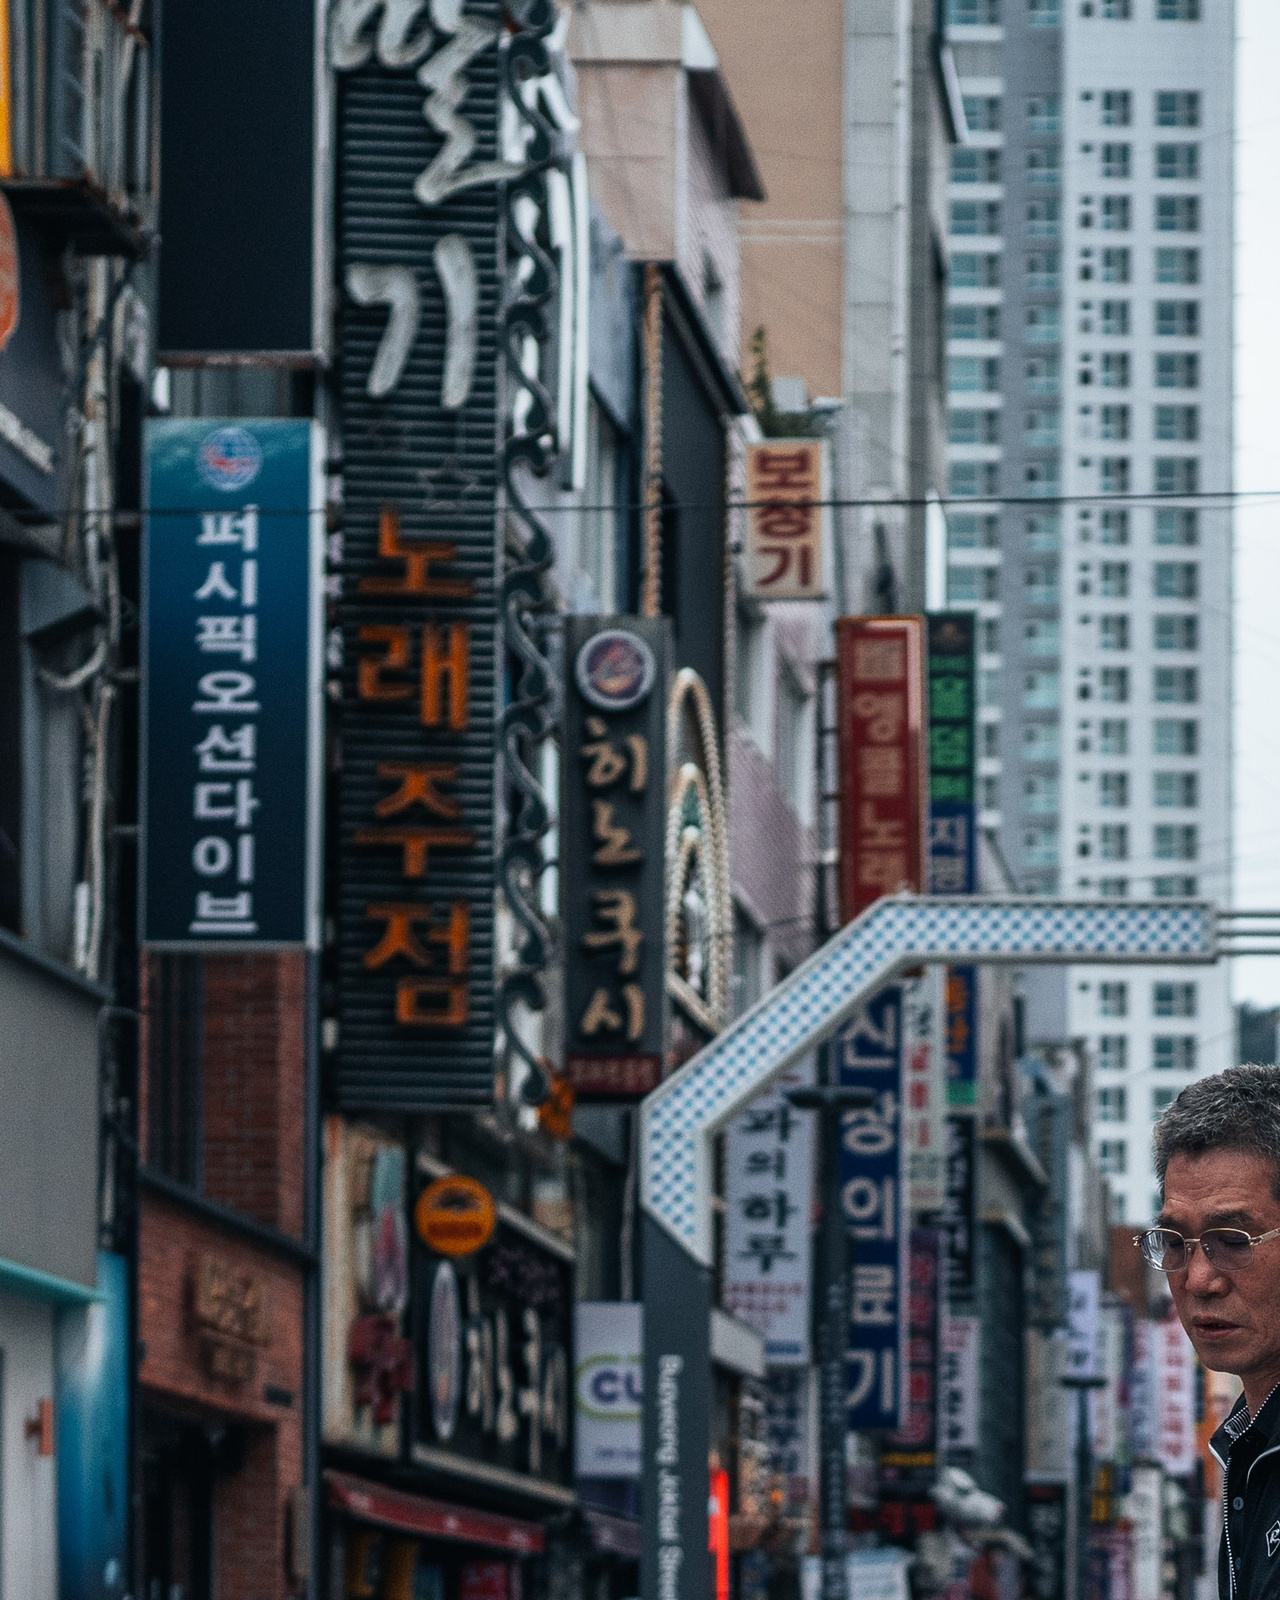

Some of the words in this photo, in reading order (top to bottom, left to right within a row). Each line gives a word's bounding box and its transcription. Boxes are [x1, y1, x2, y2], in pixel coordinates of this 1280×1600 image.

[757, 447, 811, 588] 보청기
[352, 508, 476, 1026] 노래주점
[592, 1370, 641, 1404] CU
